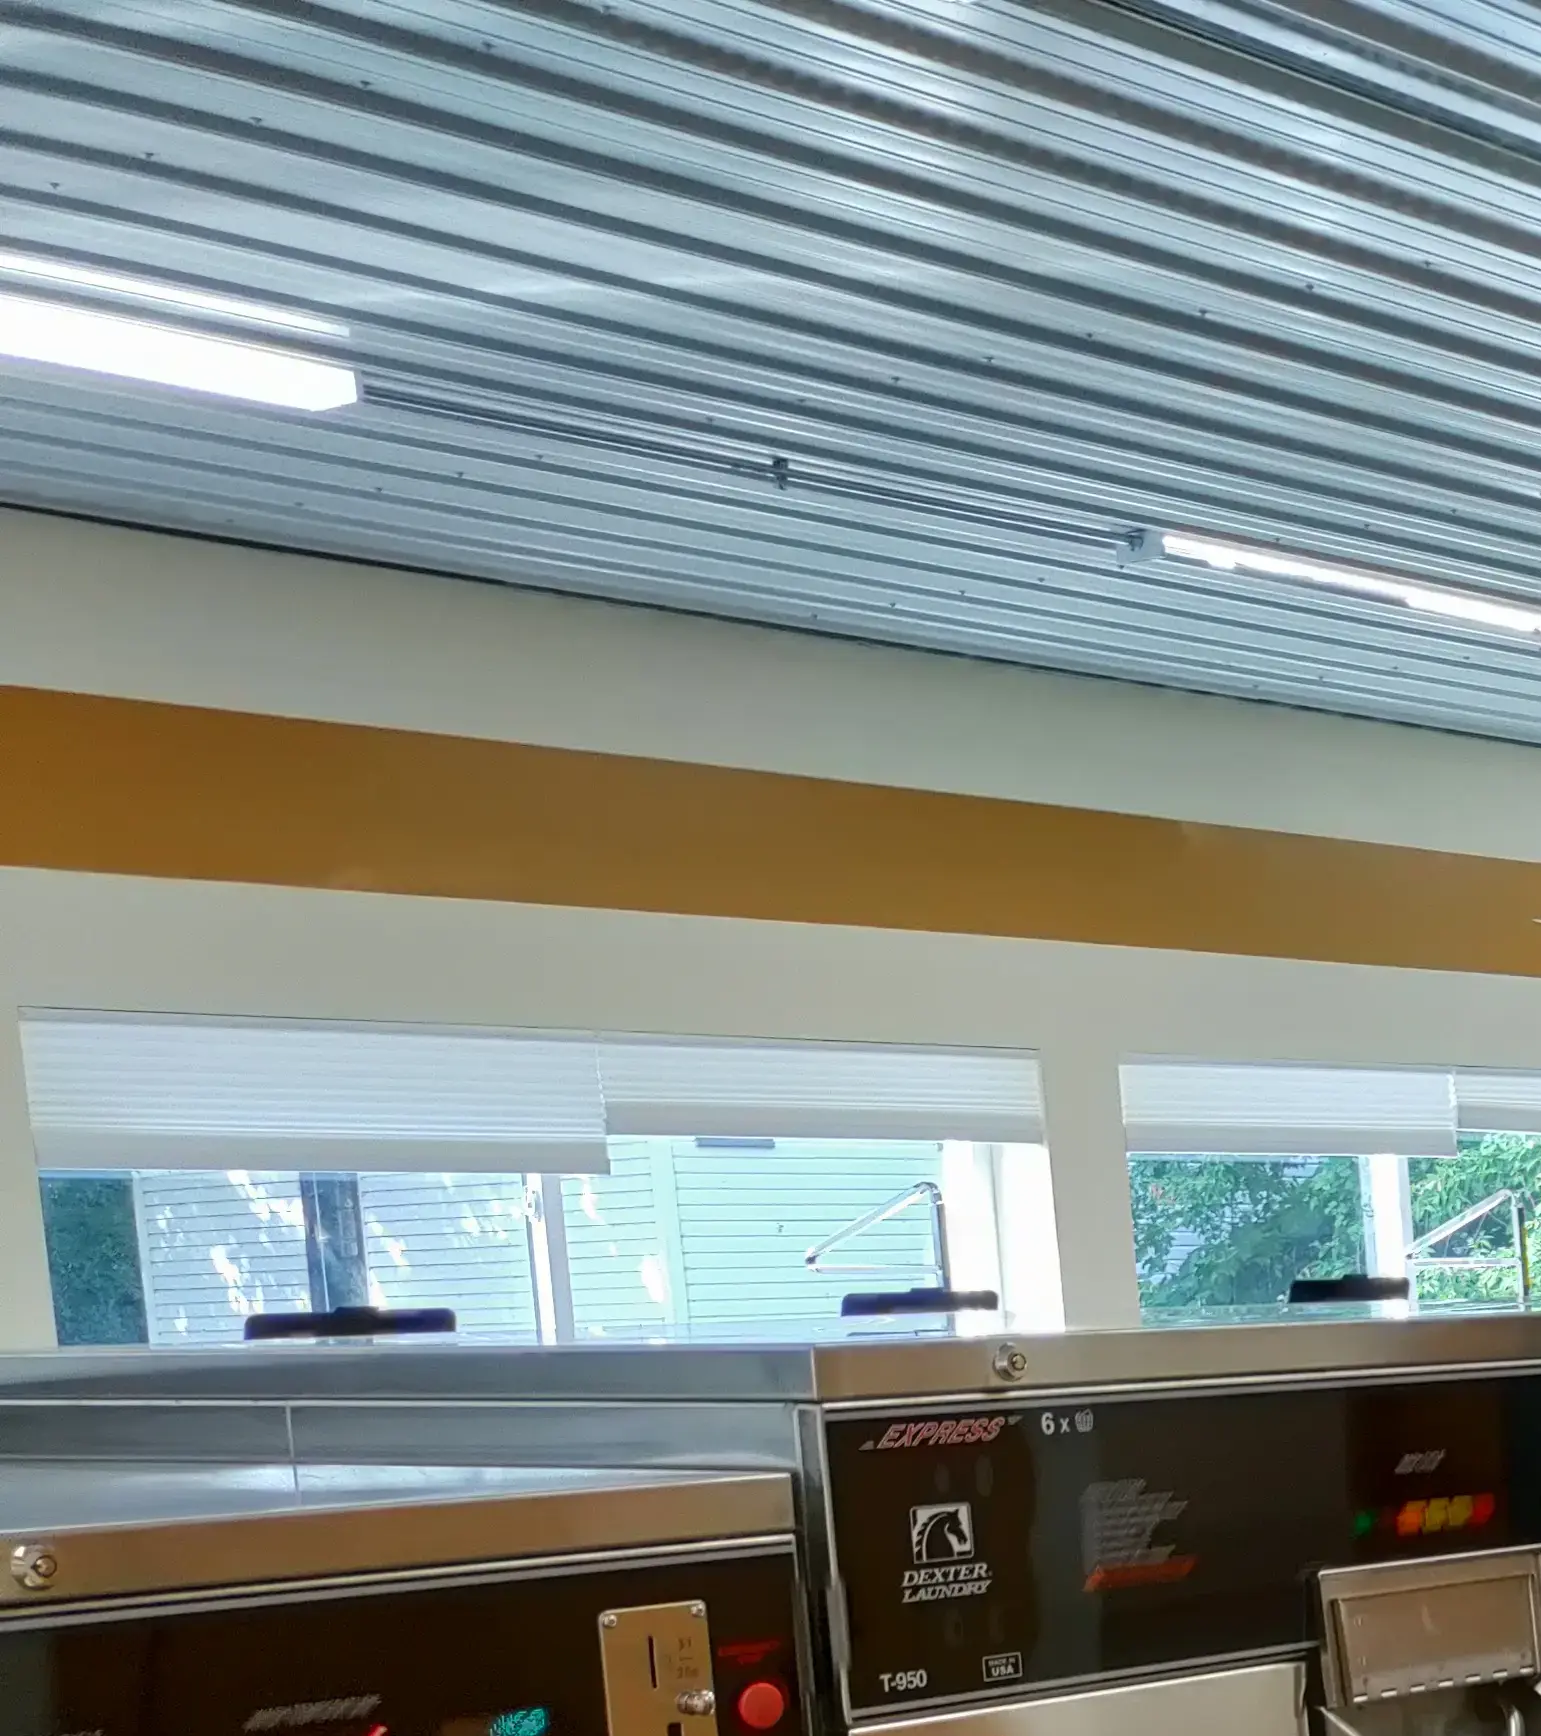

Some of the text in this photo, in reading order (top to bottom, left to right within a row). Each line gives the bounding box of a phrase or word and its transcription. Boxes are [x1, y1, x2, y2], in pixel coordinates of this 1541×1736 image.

[876, 1416, 1005, 1450] EXPRESS
[1041, 1412, 1055, 1435] 6
[901, 1561, 990, 1587] DEXTER
[901, 1580, 992, 1603] LAUNDRY
[879, 1669, 928, 1693] T-950
[991, 1663, 1014, 1677] USA
